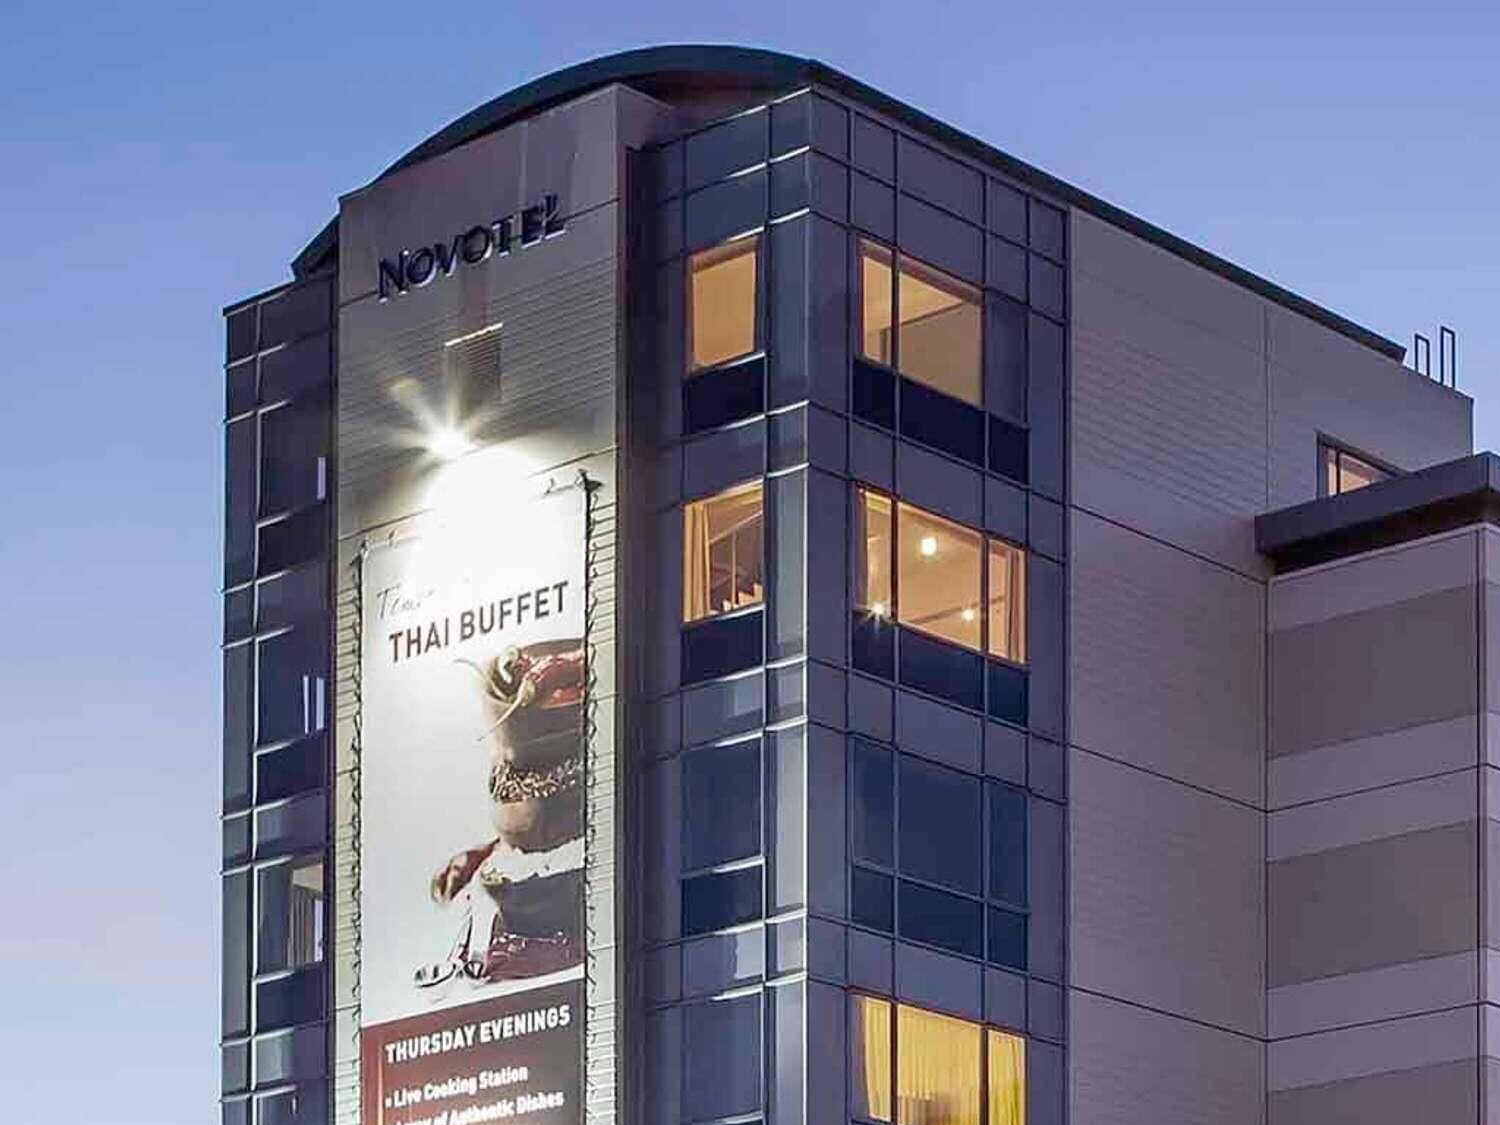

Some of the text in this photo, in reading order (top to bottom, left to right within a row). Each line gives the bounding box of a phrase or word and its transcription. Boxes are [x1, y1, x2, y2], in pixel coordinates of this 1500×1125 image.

[378, 194, 566, 303] NOVOTEL
[389, 617, 449, 663] THAI
[460, 581, 568, 641] BUFFET
[385, 1004, 571, 1064] THURSDAY EVENINGS
[393, 1066, 528, 1107] Live Cooking Station
[516, 1090, 564, 1114] Dishes
